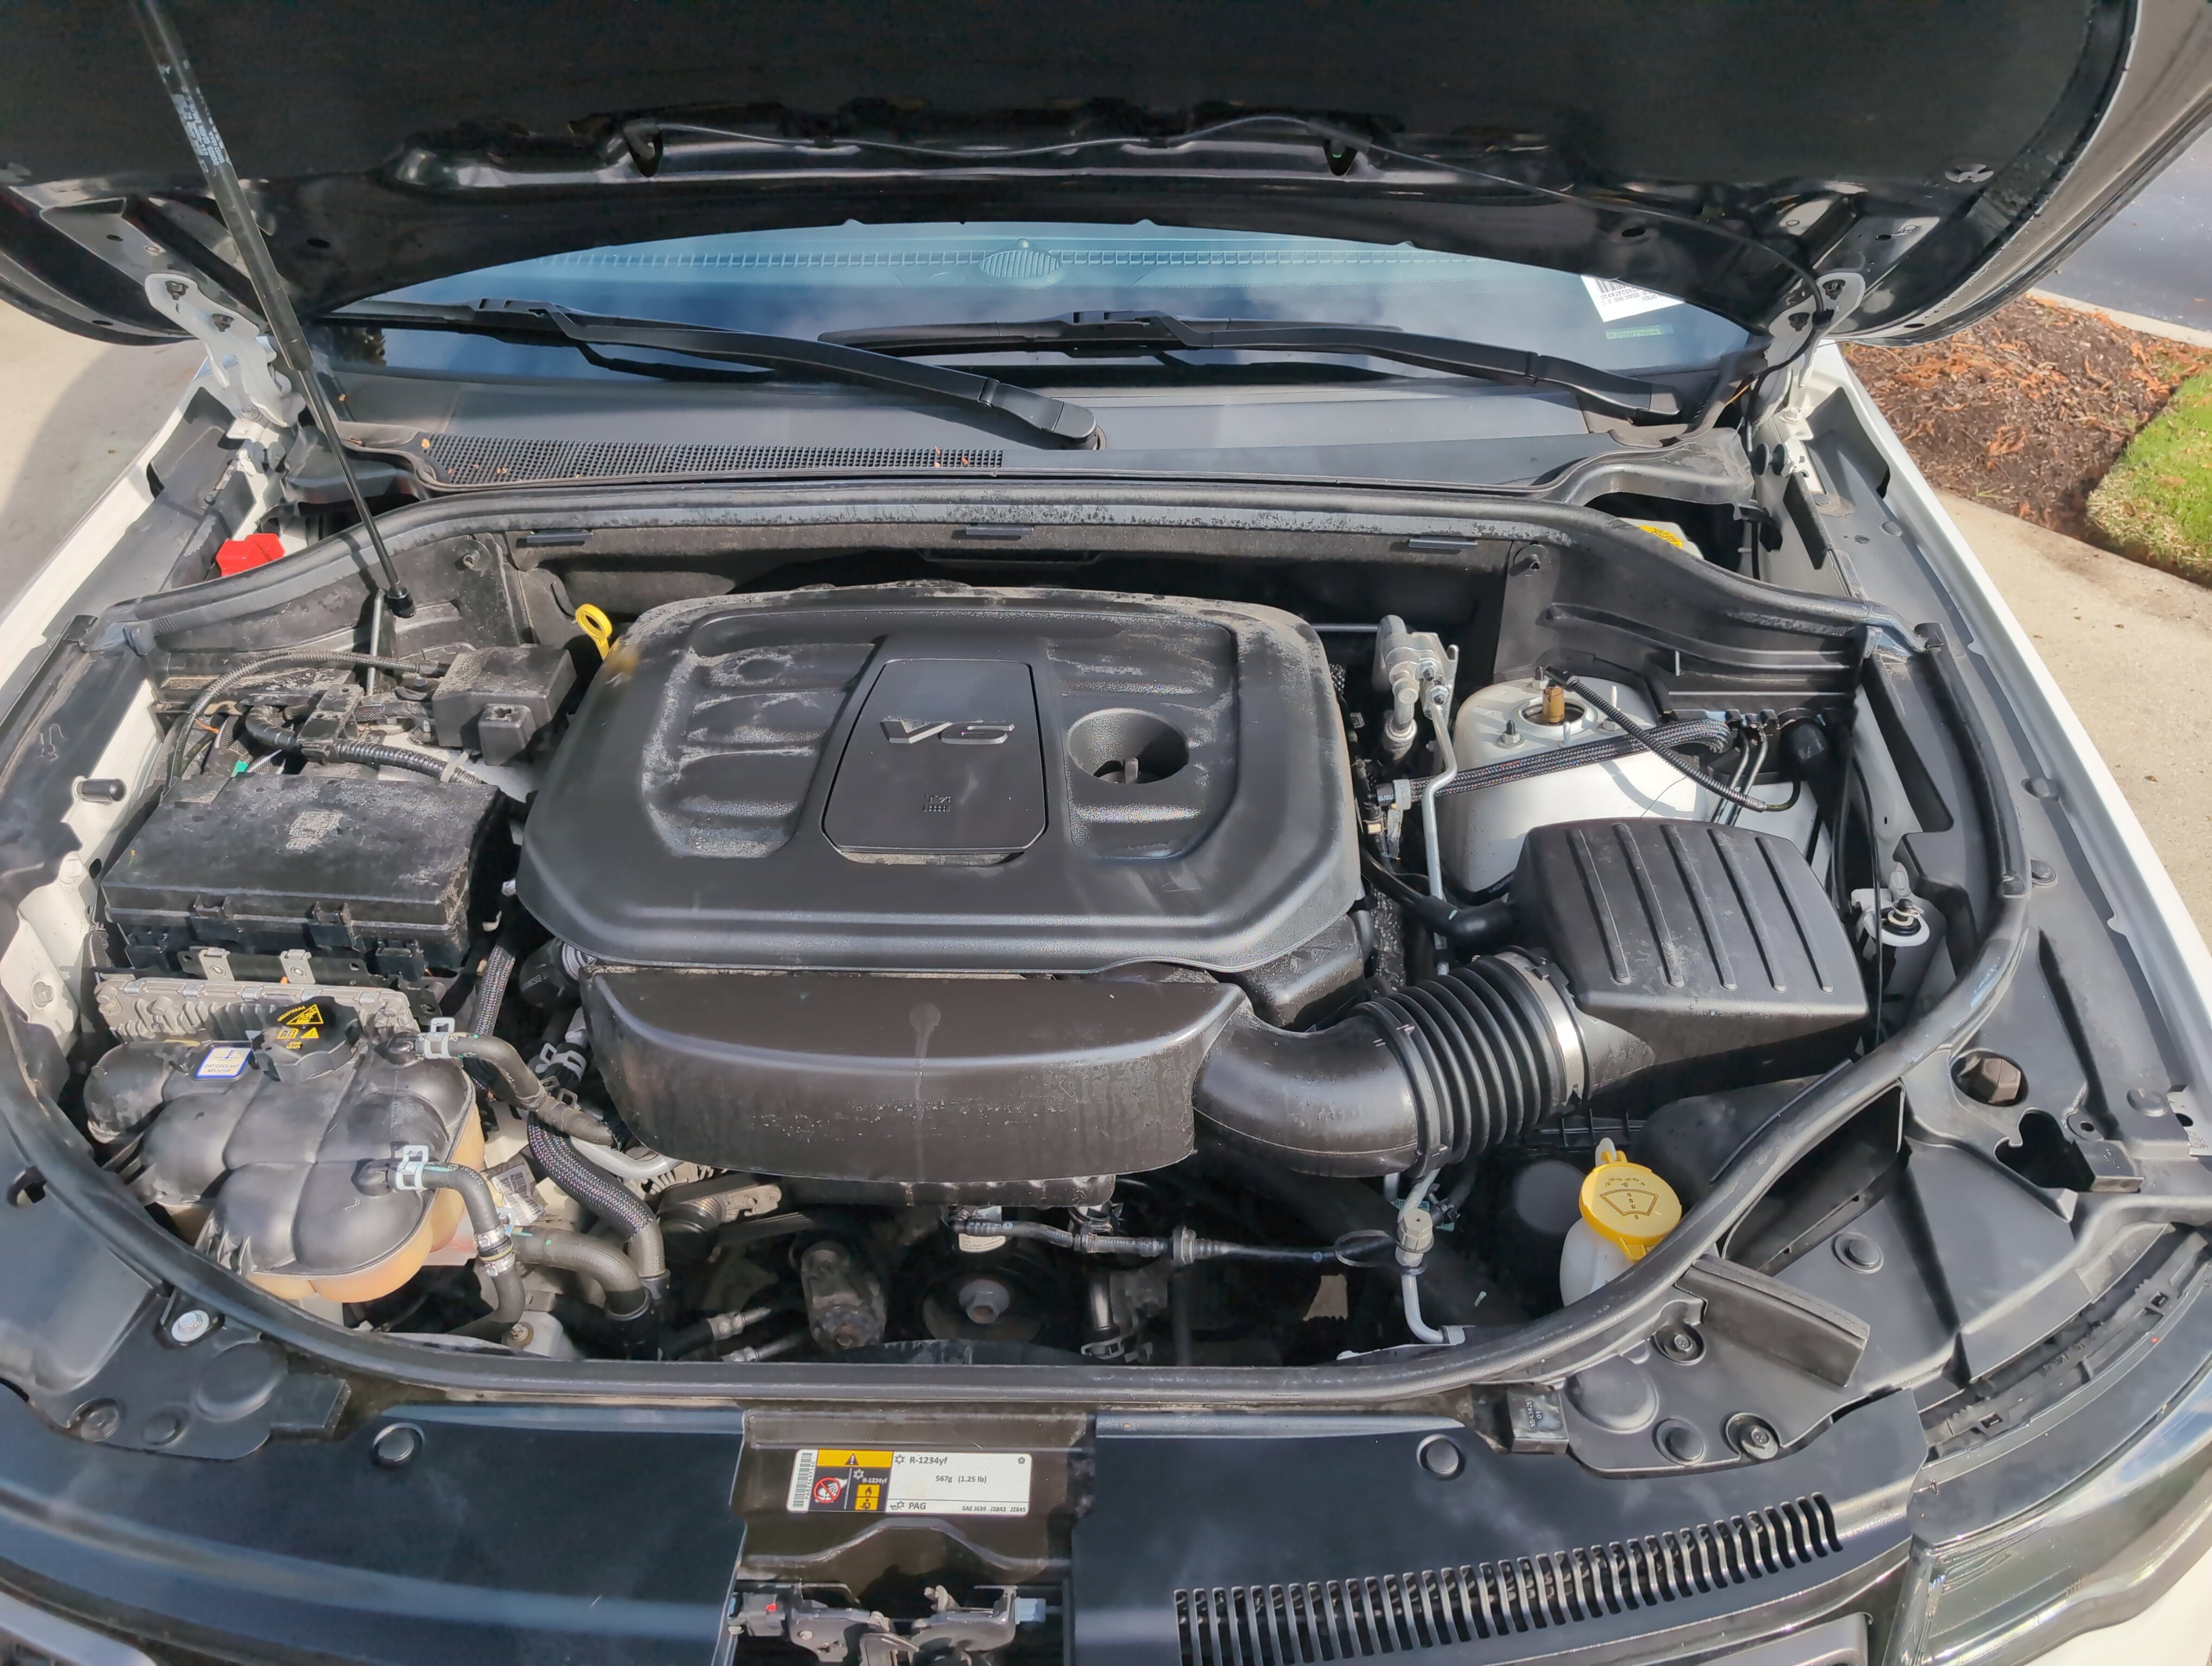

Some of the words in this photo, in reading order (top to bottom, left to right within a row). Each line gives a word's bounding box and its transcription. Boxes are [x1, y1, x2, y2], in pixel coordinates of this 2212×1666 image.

[879, 721, 1015, 745] V6
[909, 1457, 948, 1466] R-1234yf
[958, 1475, 976, 1483] (1.25
[978, 1475, 987, 1484] lb)
